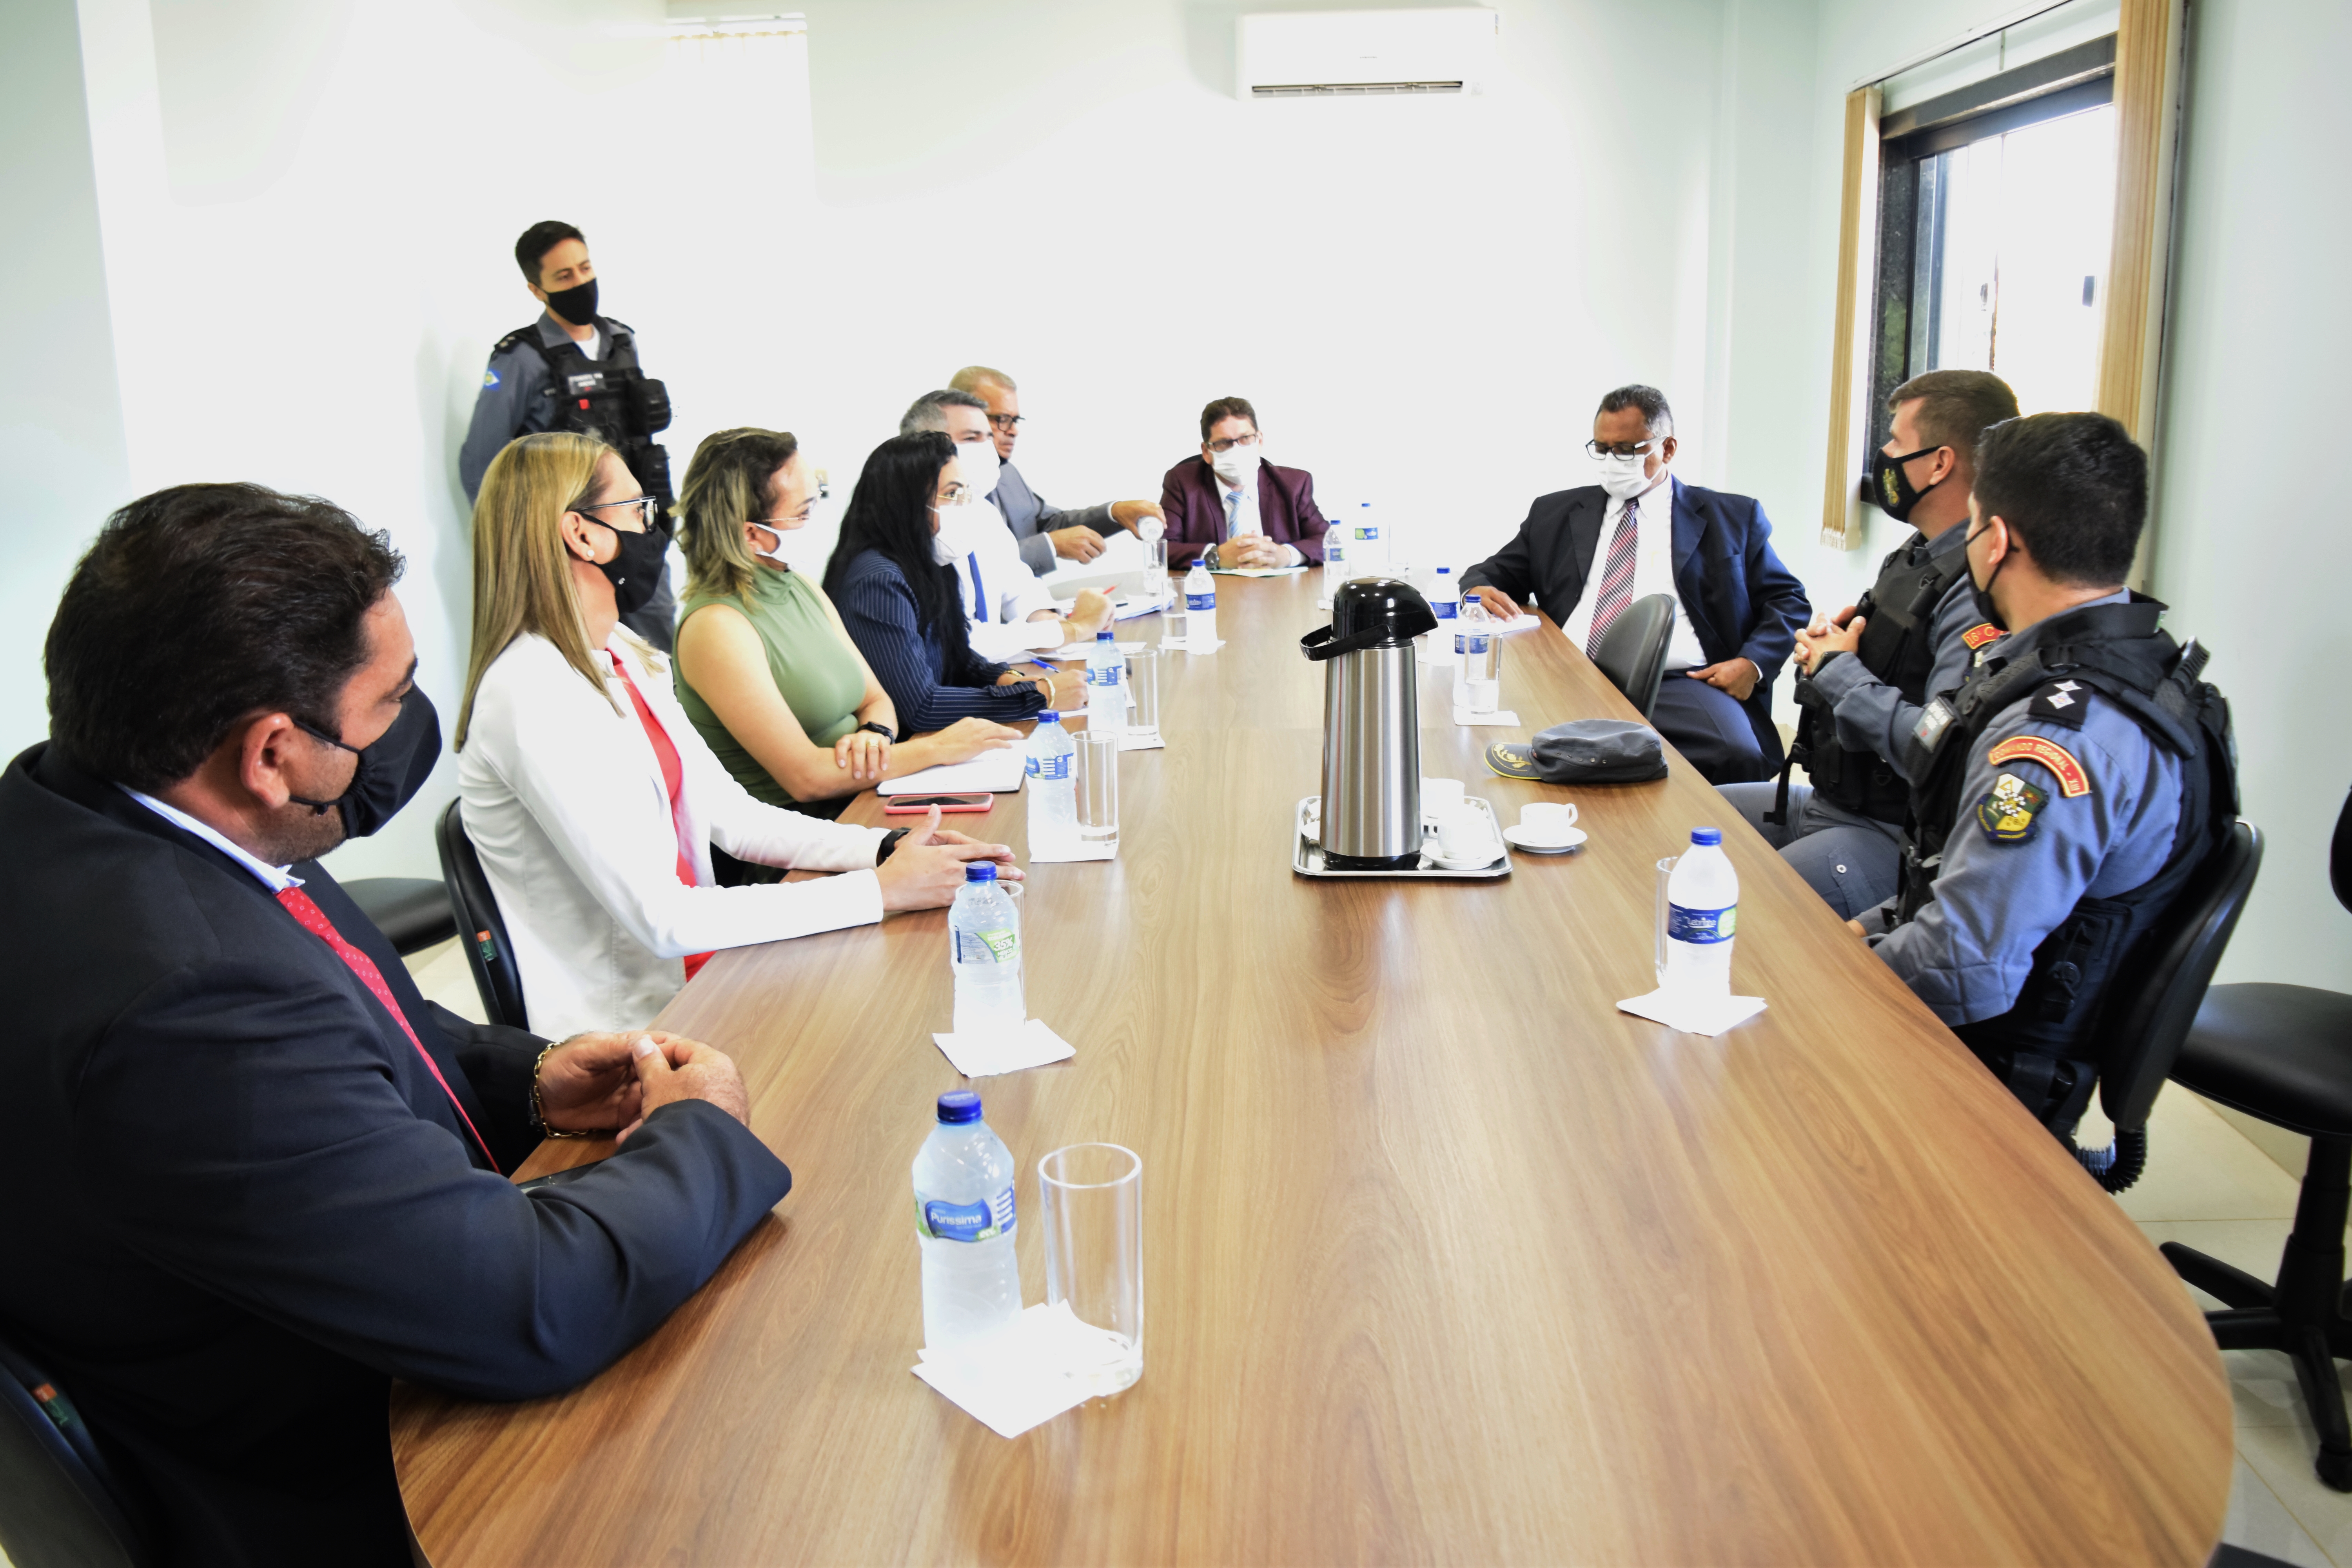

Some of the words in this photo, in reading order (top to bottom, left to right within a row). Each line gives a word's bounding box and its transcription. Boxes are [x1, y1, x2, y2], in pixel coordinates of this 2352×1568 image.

[2034, 744, 2069, 770] REGIONAL
[994, 937, 1013, 951] 35%
[931, 1212, 982, 1226] Purissima
